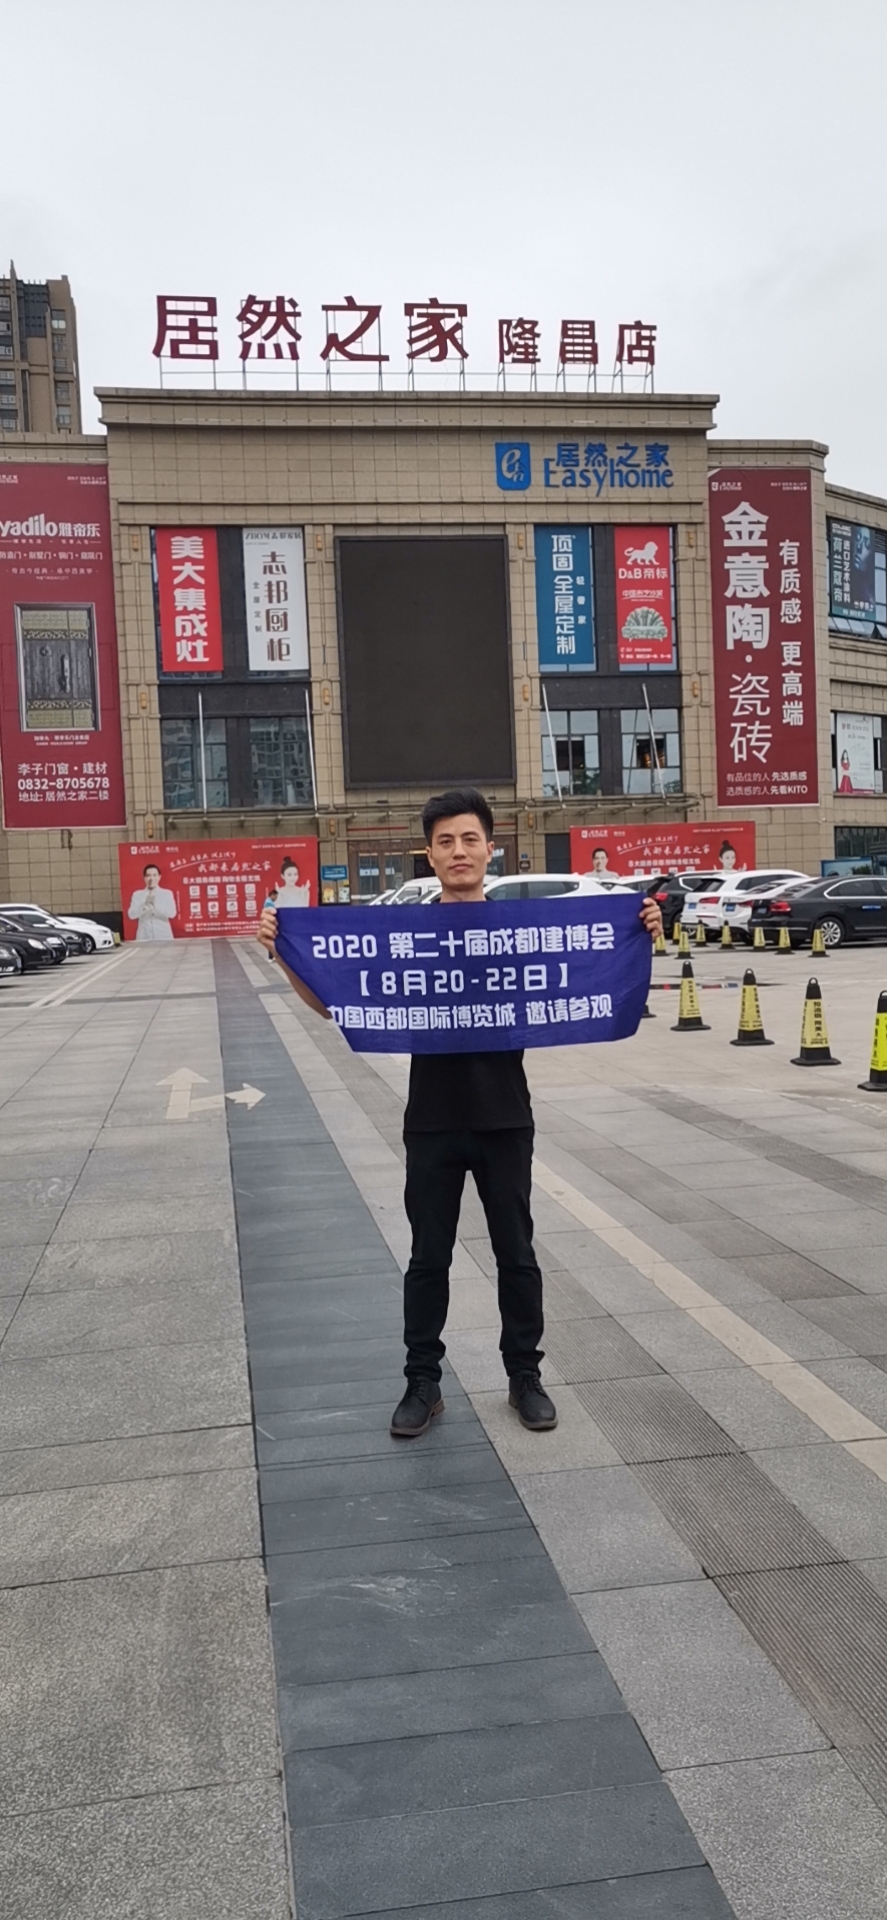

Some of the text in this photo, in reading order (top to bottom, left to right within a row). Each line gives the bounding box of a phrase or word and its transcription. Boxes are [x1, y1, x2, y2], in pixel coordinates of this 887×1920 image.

[152, 294, 657, 365] 居然之家 隆昌店
[556, 442, 669, 468] 居然之家
[543, 458, 675, 498] Easyhome
[0, 513, 101, 537] yadilo 雅帝乐
[618, 568, 642, 579] D&B
[170, 536, 210, 662] 美大集成灶
[261, 551, 291, 662] 志邦厨柜
[551, 534, 576, 655] 顶固 全屋定制
[779, 539, 804, 726] 有质感 更高端
[18, 777, 110, 790] 0832-8705678
[312, 923, 615, 959] 2020 第二十届成都建博会
[327, 994, 613, 1030] 中国西部国际博览城 邀请参观
